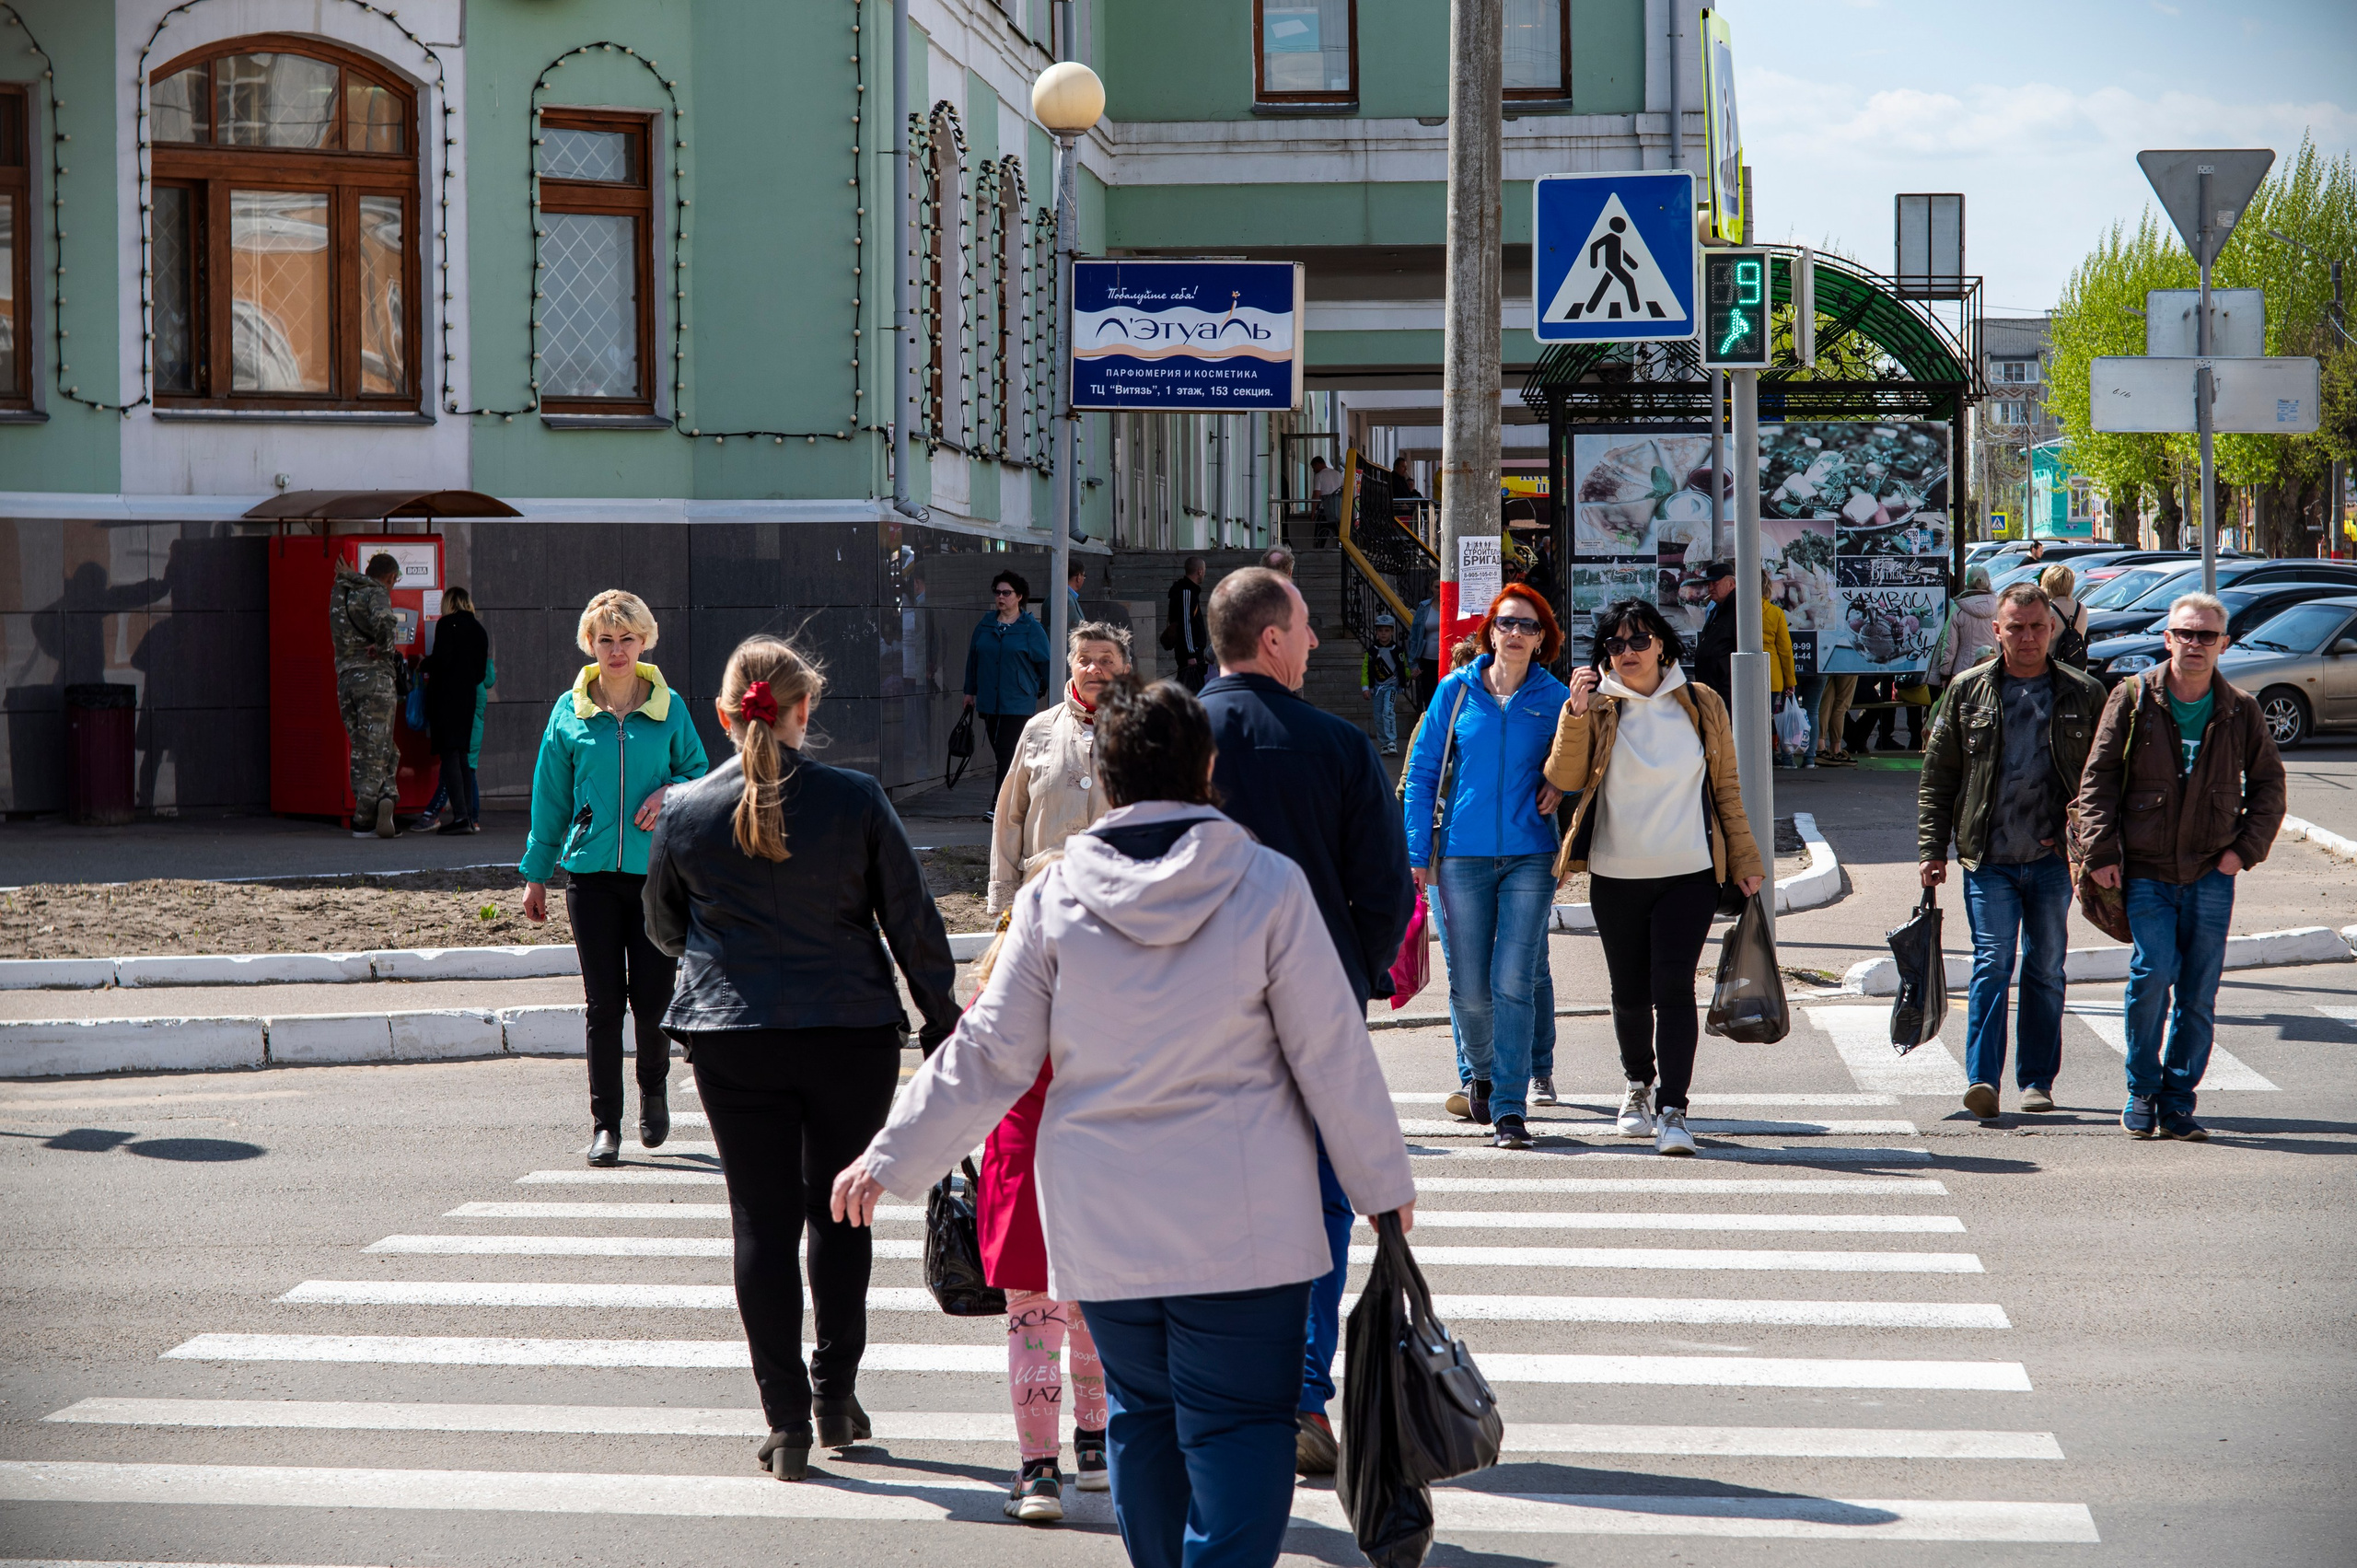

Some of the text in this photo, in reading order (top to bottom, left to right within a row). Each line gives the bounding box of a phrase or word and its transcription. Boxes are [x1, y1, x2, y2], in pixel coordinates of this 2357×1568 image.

[1737, 261, 1760, 304] 9
[1108, 285, 1198, 305] Побалуйте себя!
[1106, 368, 1258, 378] ПАРФЮМЕРИЯ И КОСМЕТИКА
[1090, 384, 1105, 396] ТЦ
[1166, 386, 1170, 395] 1
[1177, 387, 1204, 398] этаж,
[1210, 386, 1228, 396] 153
[1233, 388, 1273, 398] секция.
[1463, 555, 1501, 567] БРИГАД
[1017, 1386, 1062, 1406] JAZ
